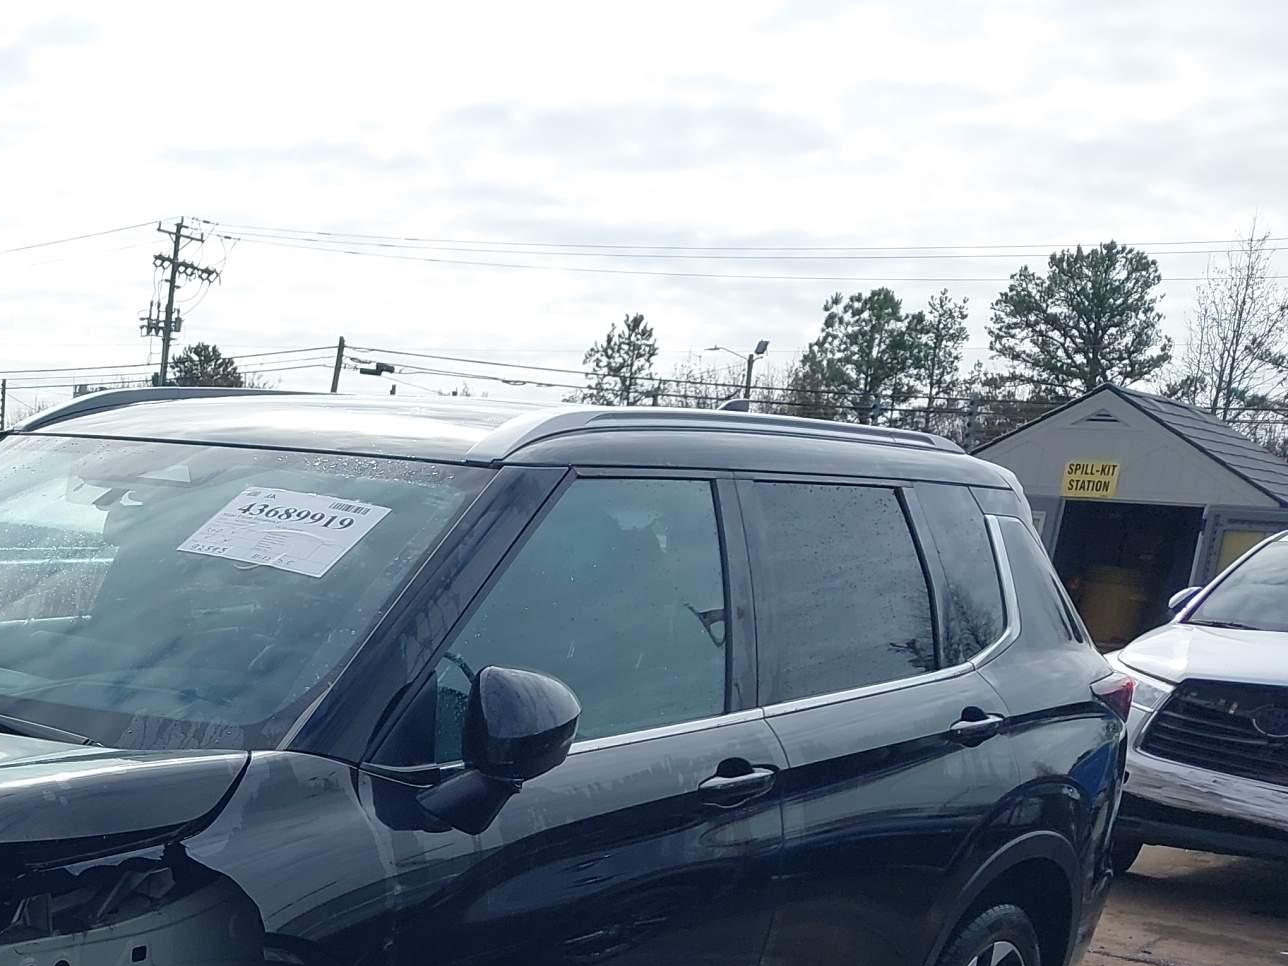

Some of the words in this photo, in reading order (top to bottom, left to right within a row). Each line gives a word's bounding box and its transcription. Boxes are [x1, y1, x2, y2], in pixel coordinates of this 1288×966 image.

[1067, 463, 1118, 477] SPILL-KIT
[1067, 478, 1111, 492] STATION
[237, 502, 355, 530] 43689919
